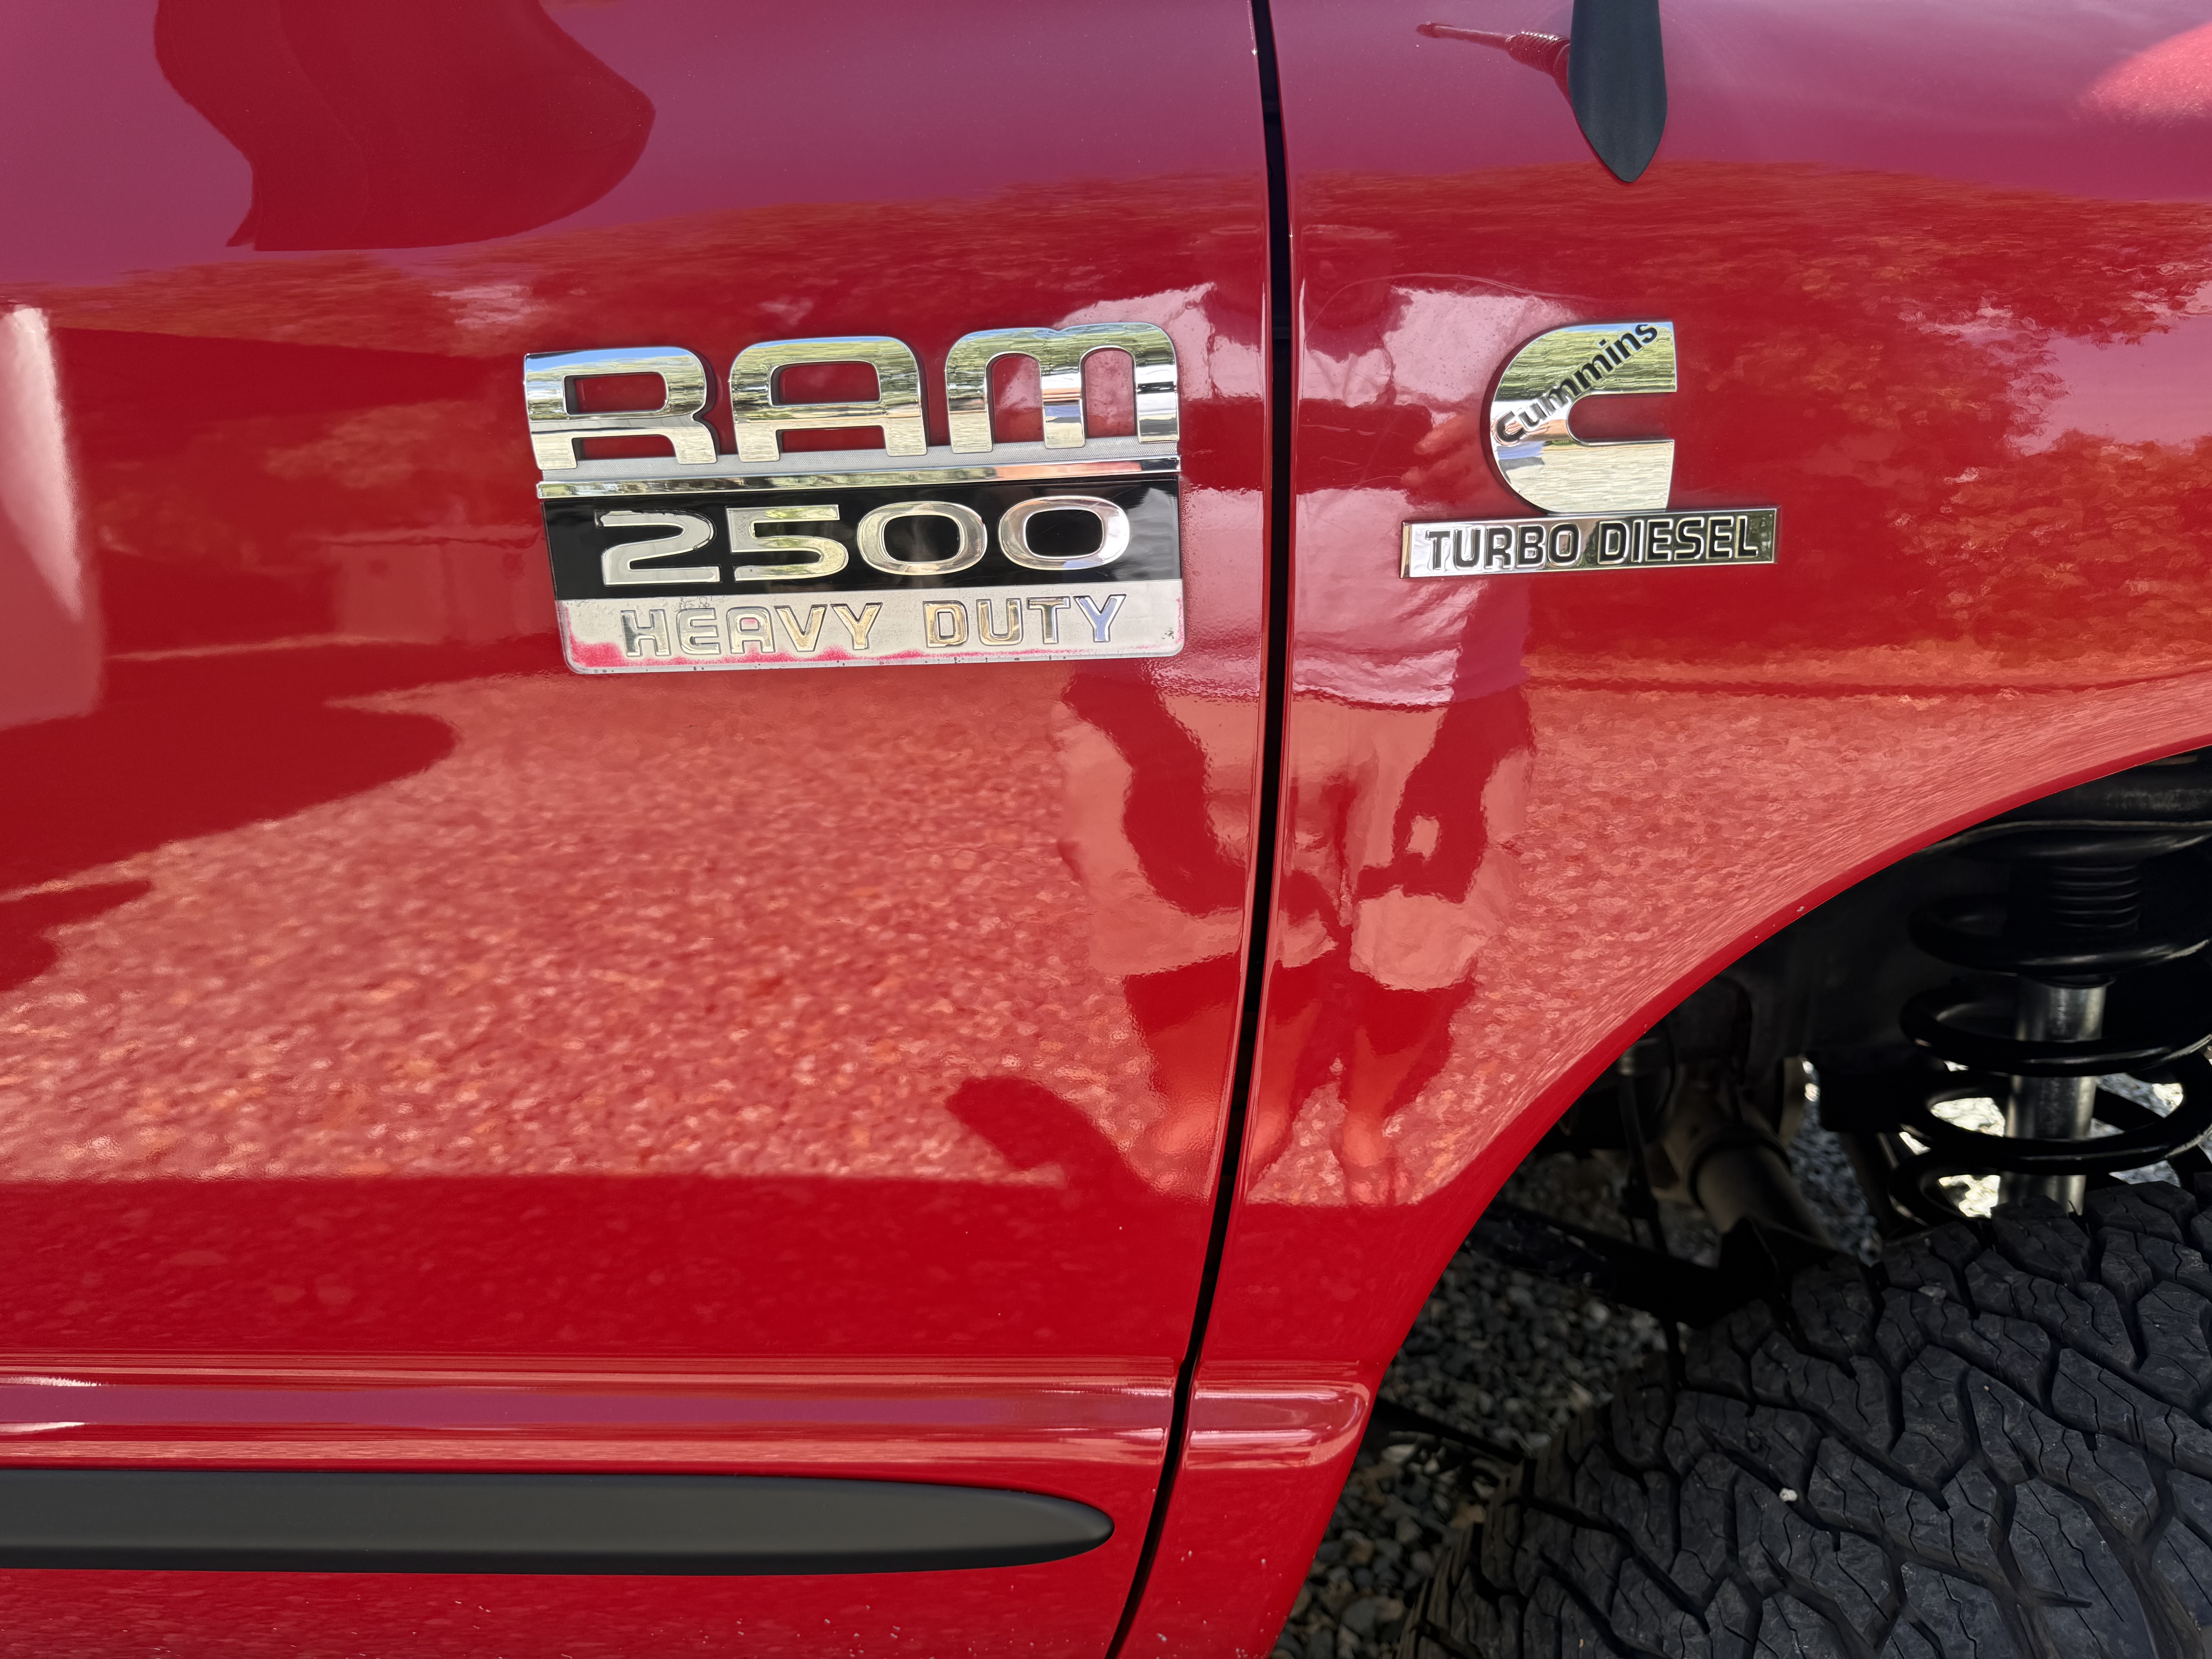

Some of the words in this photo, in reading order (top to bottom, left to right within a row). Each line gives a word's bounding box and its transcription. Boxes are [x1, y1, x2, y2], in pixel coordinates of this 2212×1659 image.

[524, 323, 1180, 470] RAM
[1493, 323, 1659, 445] Cummins
[595, 496, 1131, 586] 2500
[1425, 522, 1579, 570] TURBO
[1597, 516, 1759, 565] DIESEL
[620, 602, 883, 658] HEAVY
[923, 594, 1126, 648] DUTY
